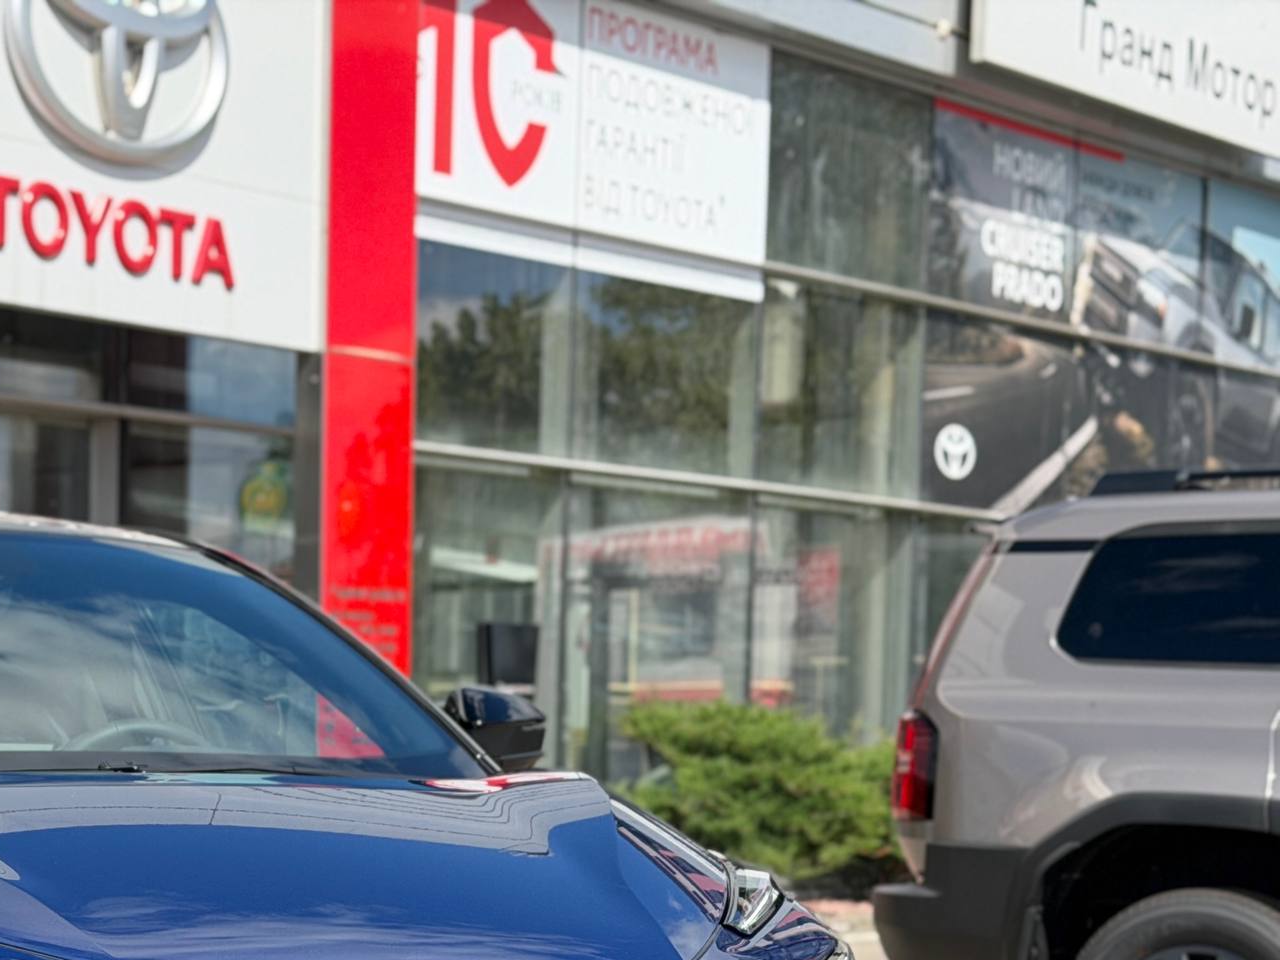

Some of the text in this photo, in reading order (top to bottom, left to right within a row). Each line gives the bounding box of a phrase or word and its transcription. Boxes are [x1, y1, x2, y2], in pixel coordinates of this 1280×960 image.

[587, 5, 720, 77] ПРОГРАМА
[1079, 0, 1277, 131] Гранд Мотор
